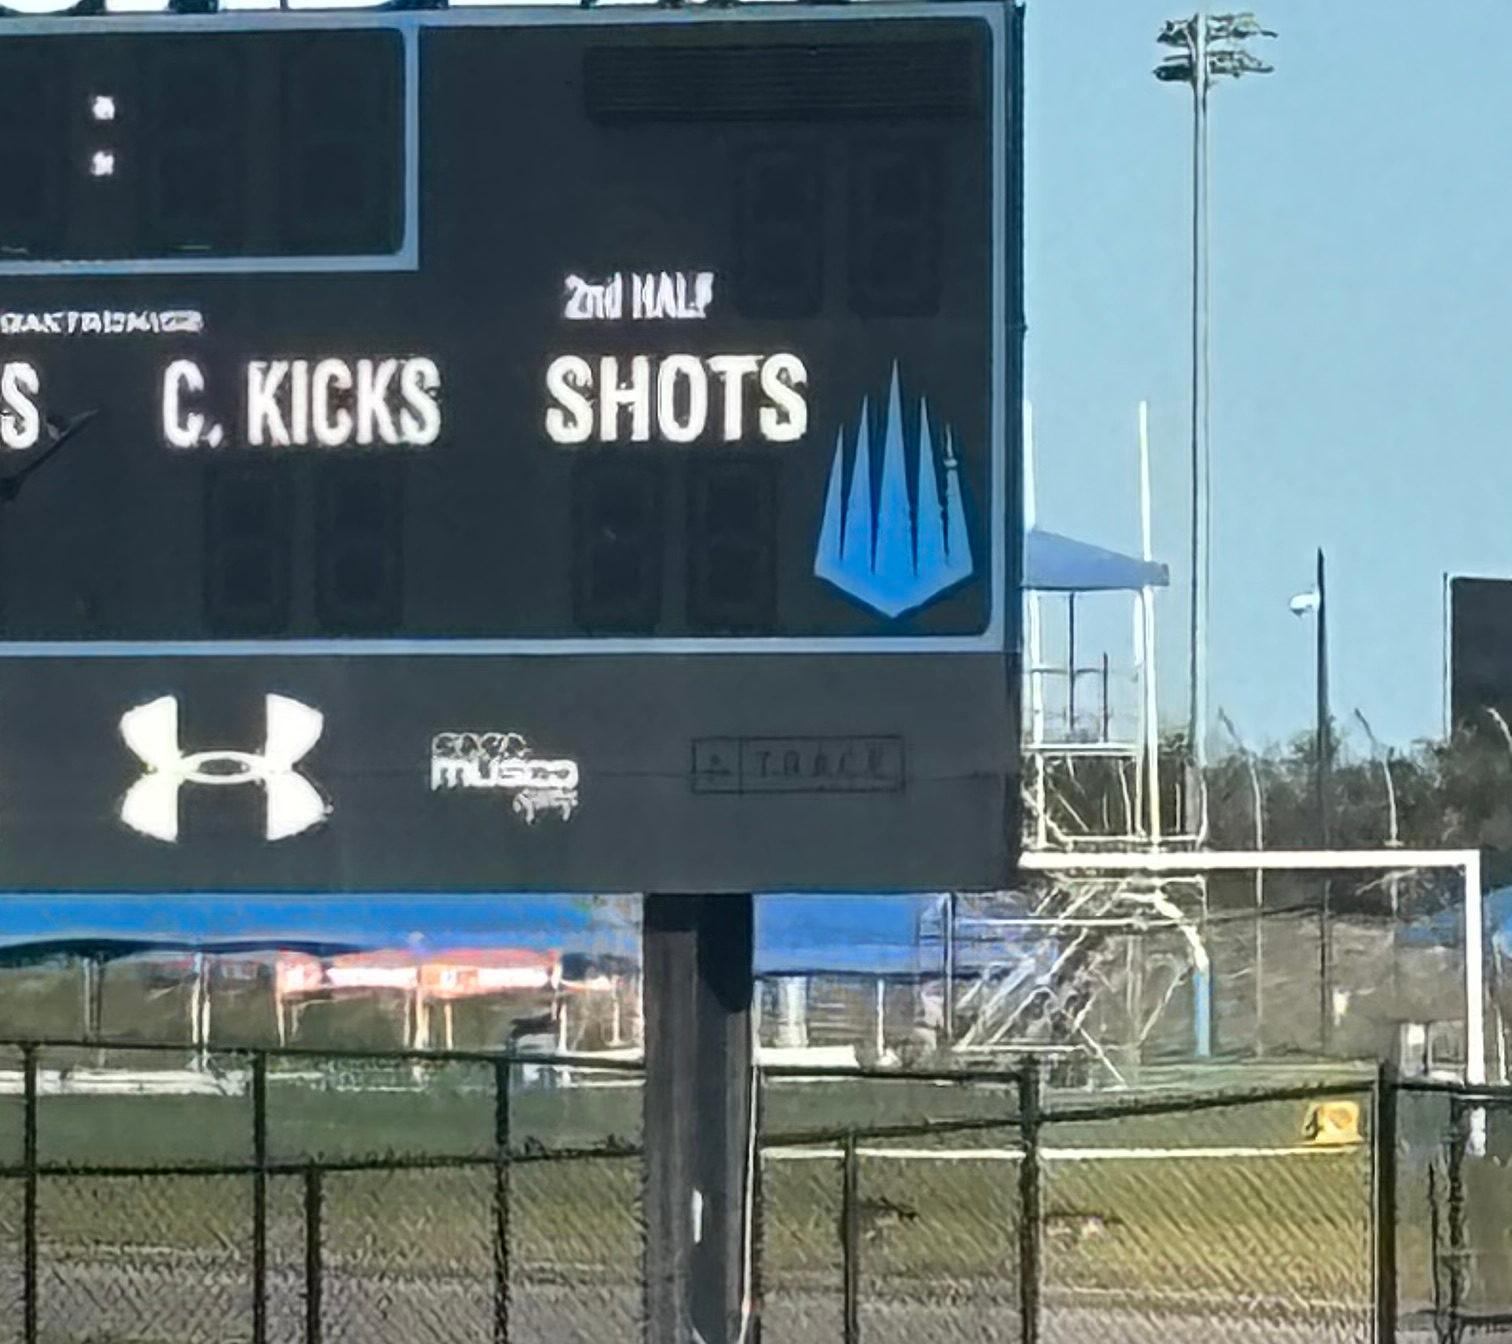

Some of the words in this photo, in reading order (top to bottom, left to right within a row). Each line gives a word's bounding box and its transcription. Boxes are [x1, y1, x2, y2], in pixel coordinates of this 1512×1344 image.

[564, 271, 624, 320] 2nd
[631, 271, 715, 320] HALF
[161, 359, 223, 449] C.
[247, 356, 441, 447] KICKS
[545, 352, 808, 444] SHOTS
